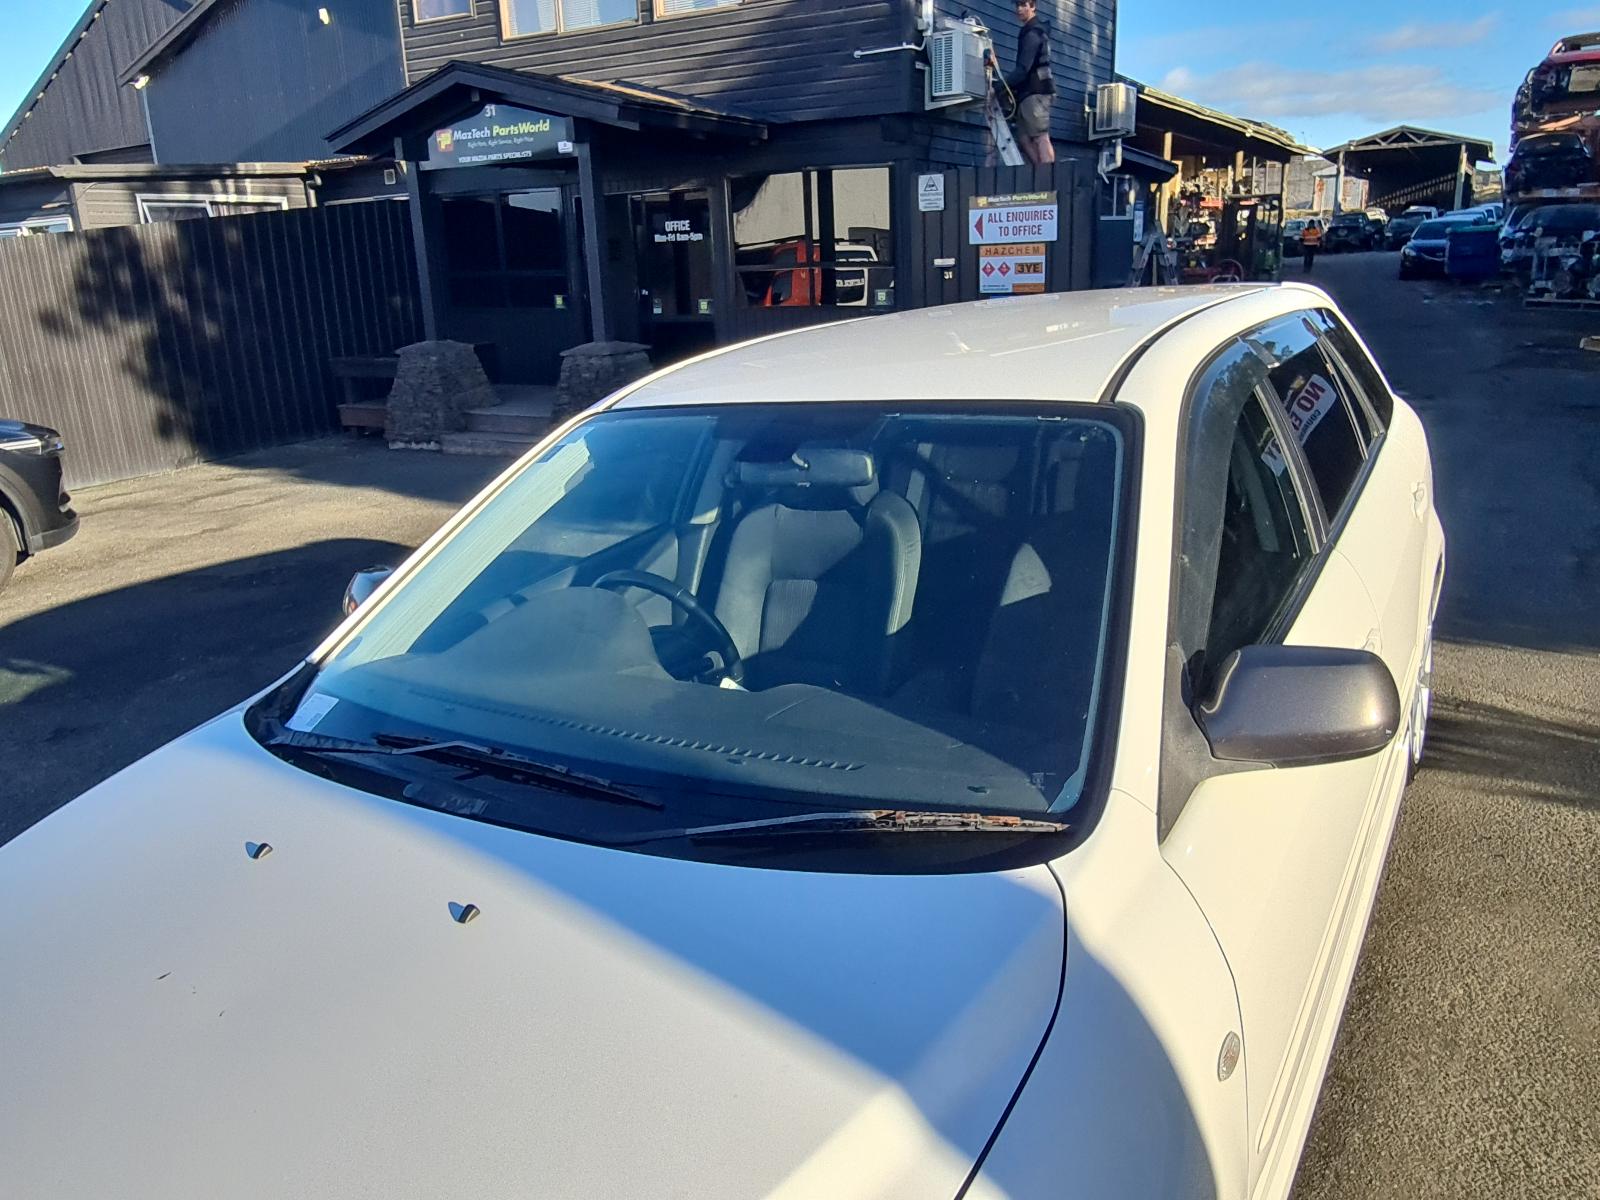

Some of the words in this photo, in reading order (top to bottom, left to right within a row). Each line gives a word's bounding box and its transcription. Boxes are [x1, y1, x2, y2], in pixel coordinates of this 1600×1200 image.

[484, 105, 496, 117] 31
[453, 127, 491, 141] MazTech
[493, 119, 550, 136] PartsWorld
[988, 212, 1003, 223] ALL
[1006, 209, 1054, 222] ENQUIRIES
[665, 220, 690, 232] OFFICE
[998, 226, 1009, 237] TO
[1012, 224, 1043, 236] OFFICE
[984, 245, 1040, 256] HAZCHEM
[1017, 262, 1041, 273] 3YE
